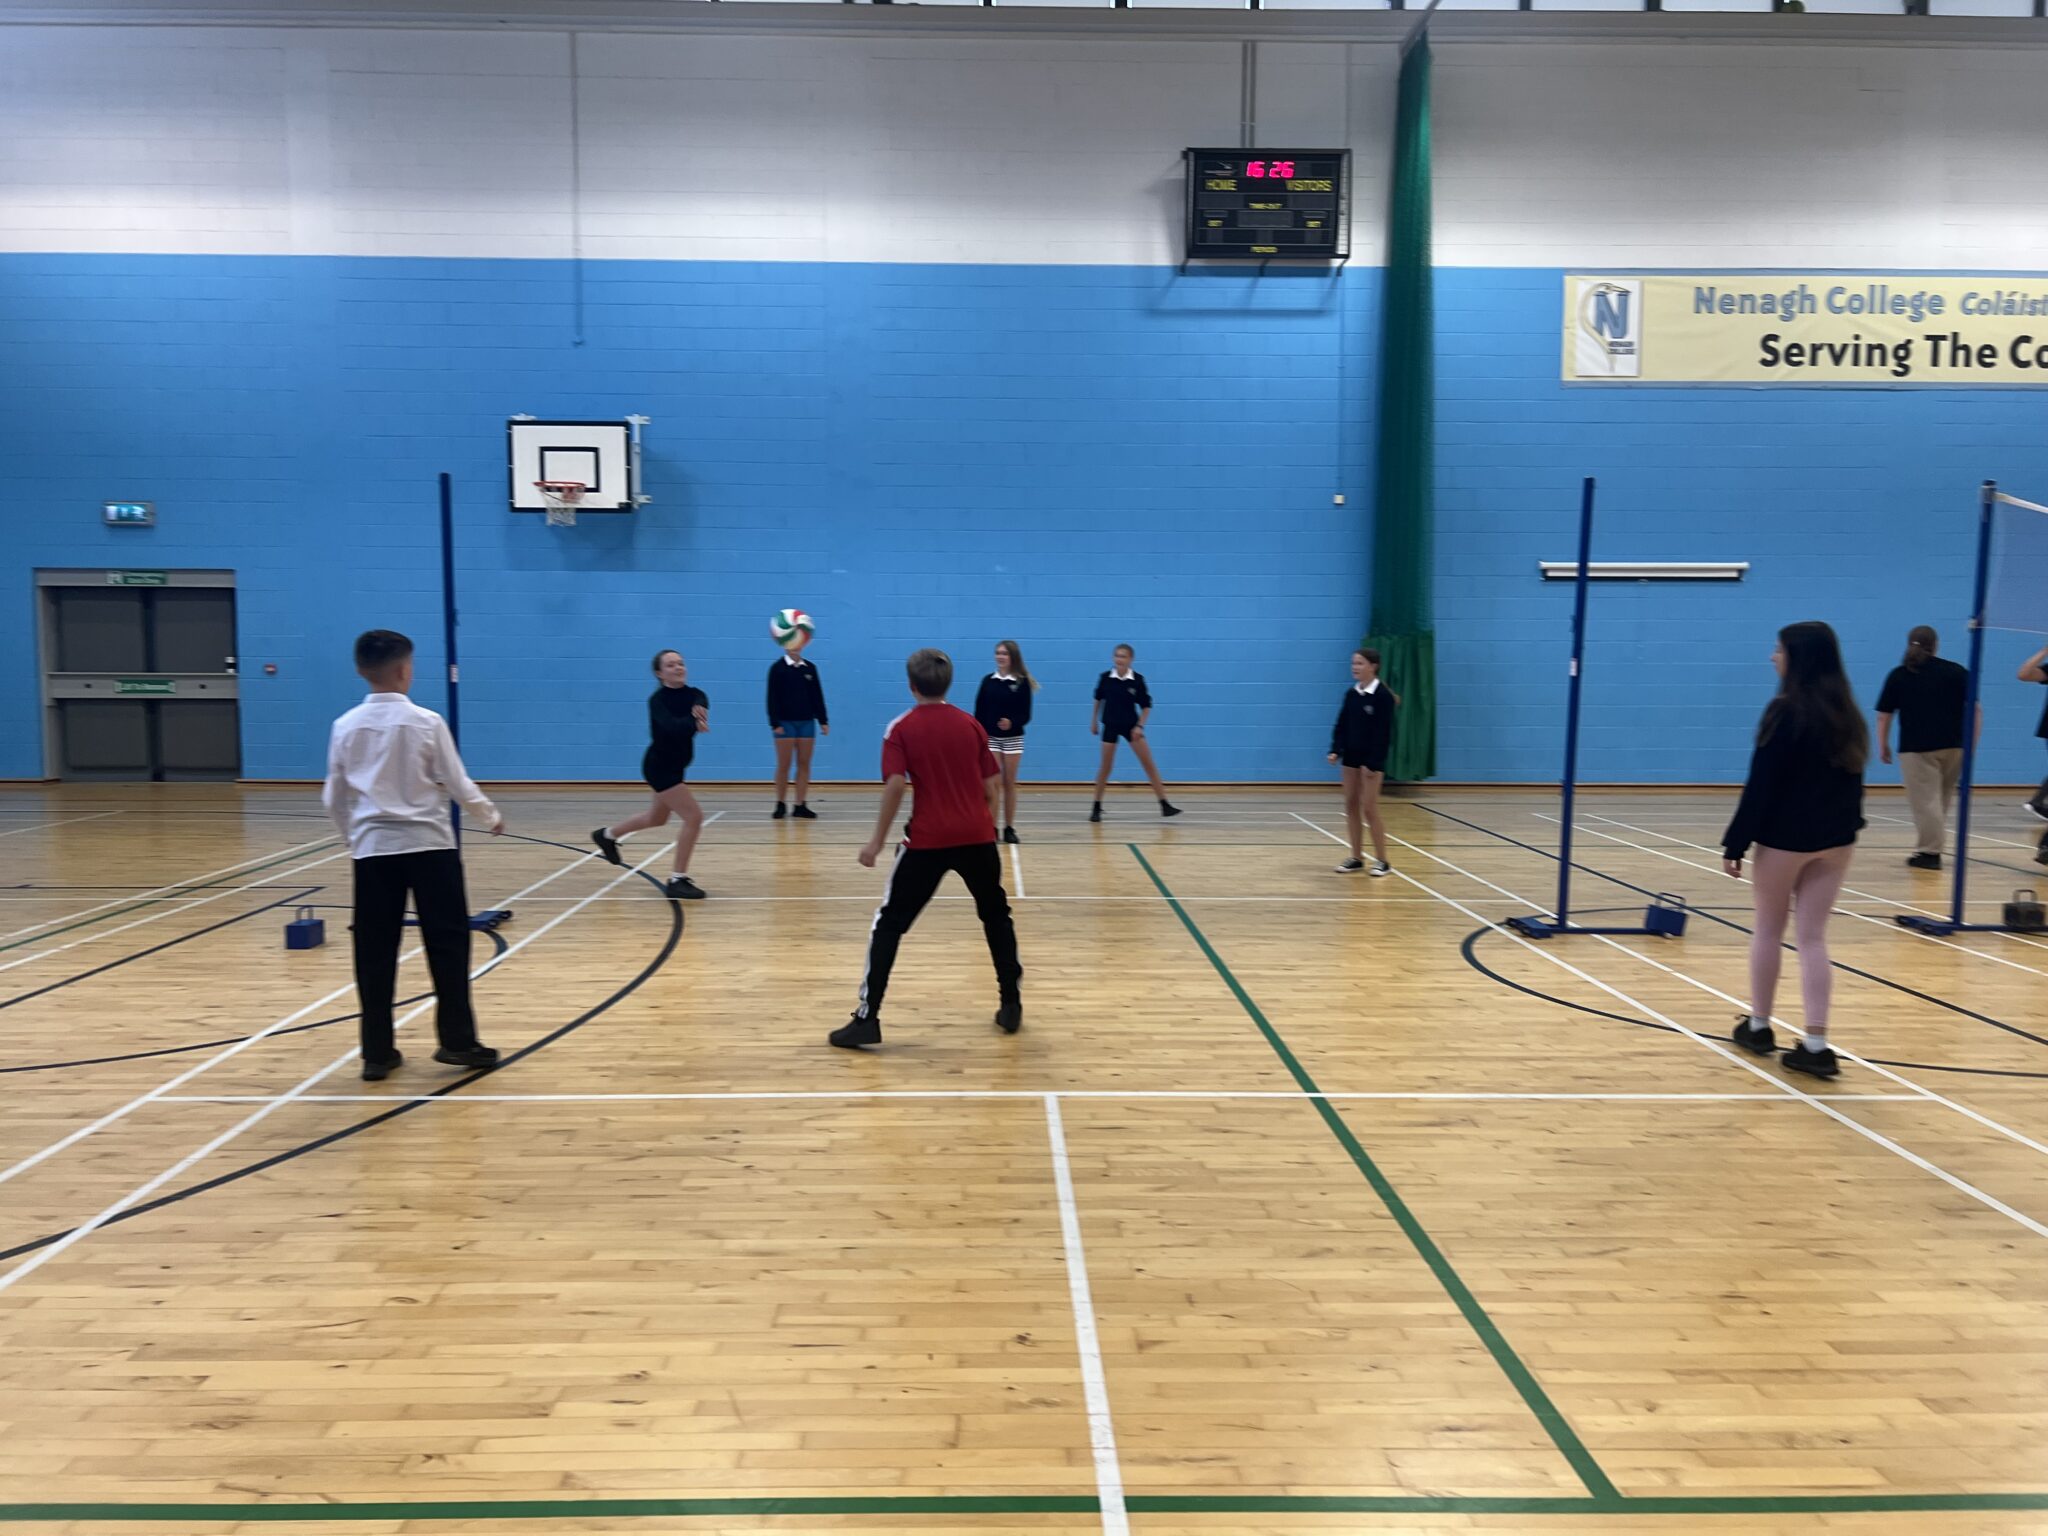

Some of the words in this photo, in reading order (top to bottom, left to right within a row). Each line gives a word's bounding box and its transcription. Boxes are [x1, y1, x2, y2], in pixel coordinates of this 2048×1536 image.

[1593, 292, 1631, 340] N
[1693, 285, 1817, 322] Nenagh
[1826, 285, 1945, 323] College
[1759, 333, 1912, 377] Serving
[1925, 332, 1998, 368] The
